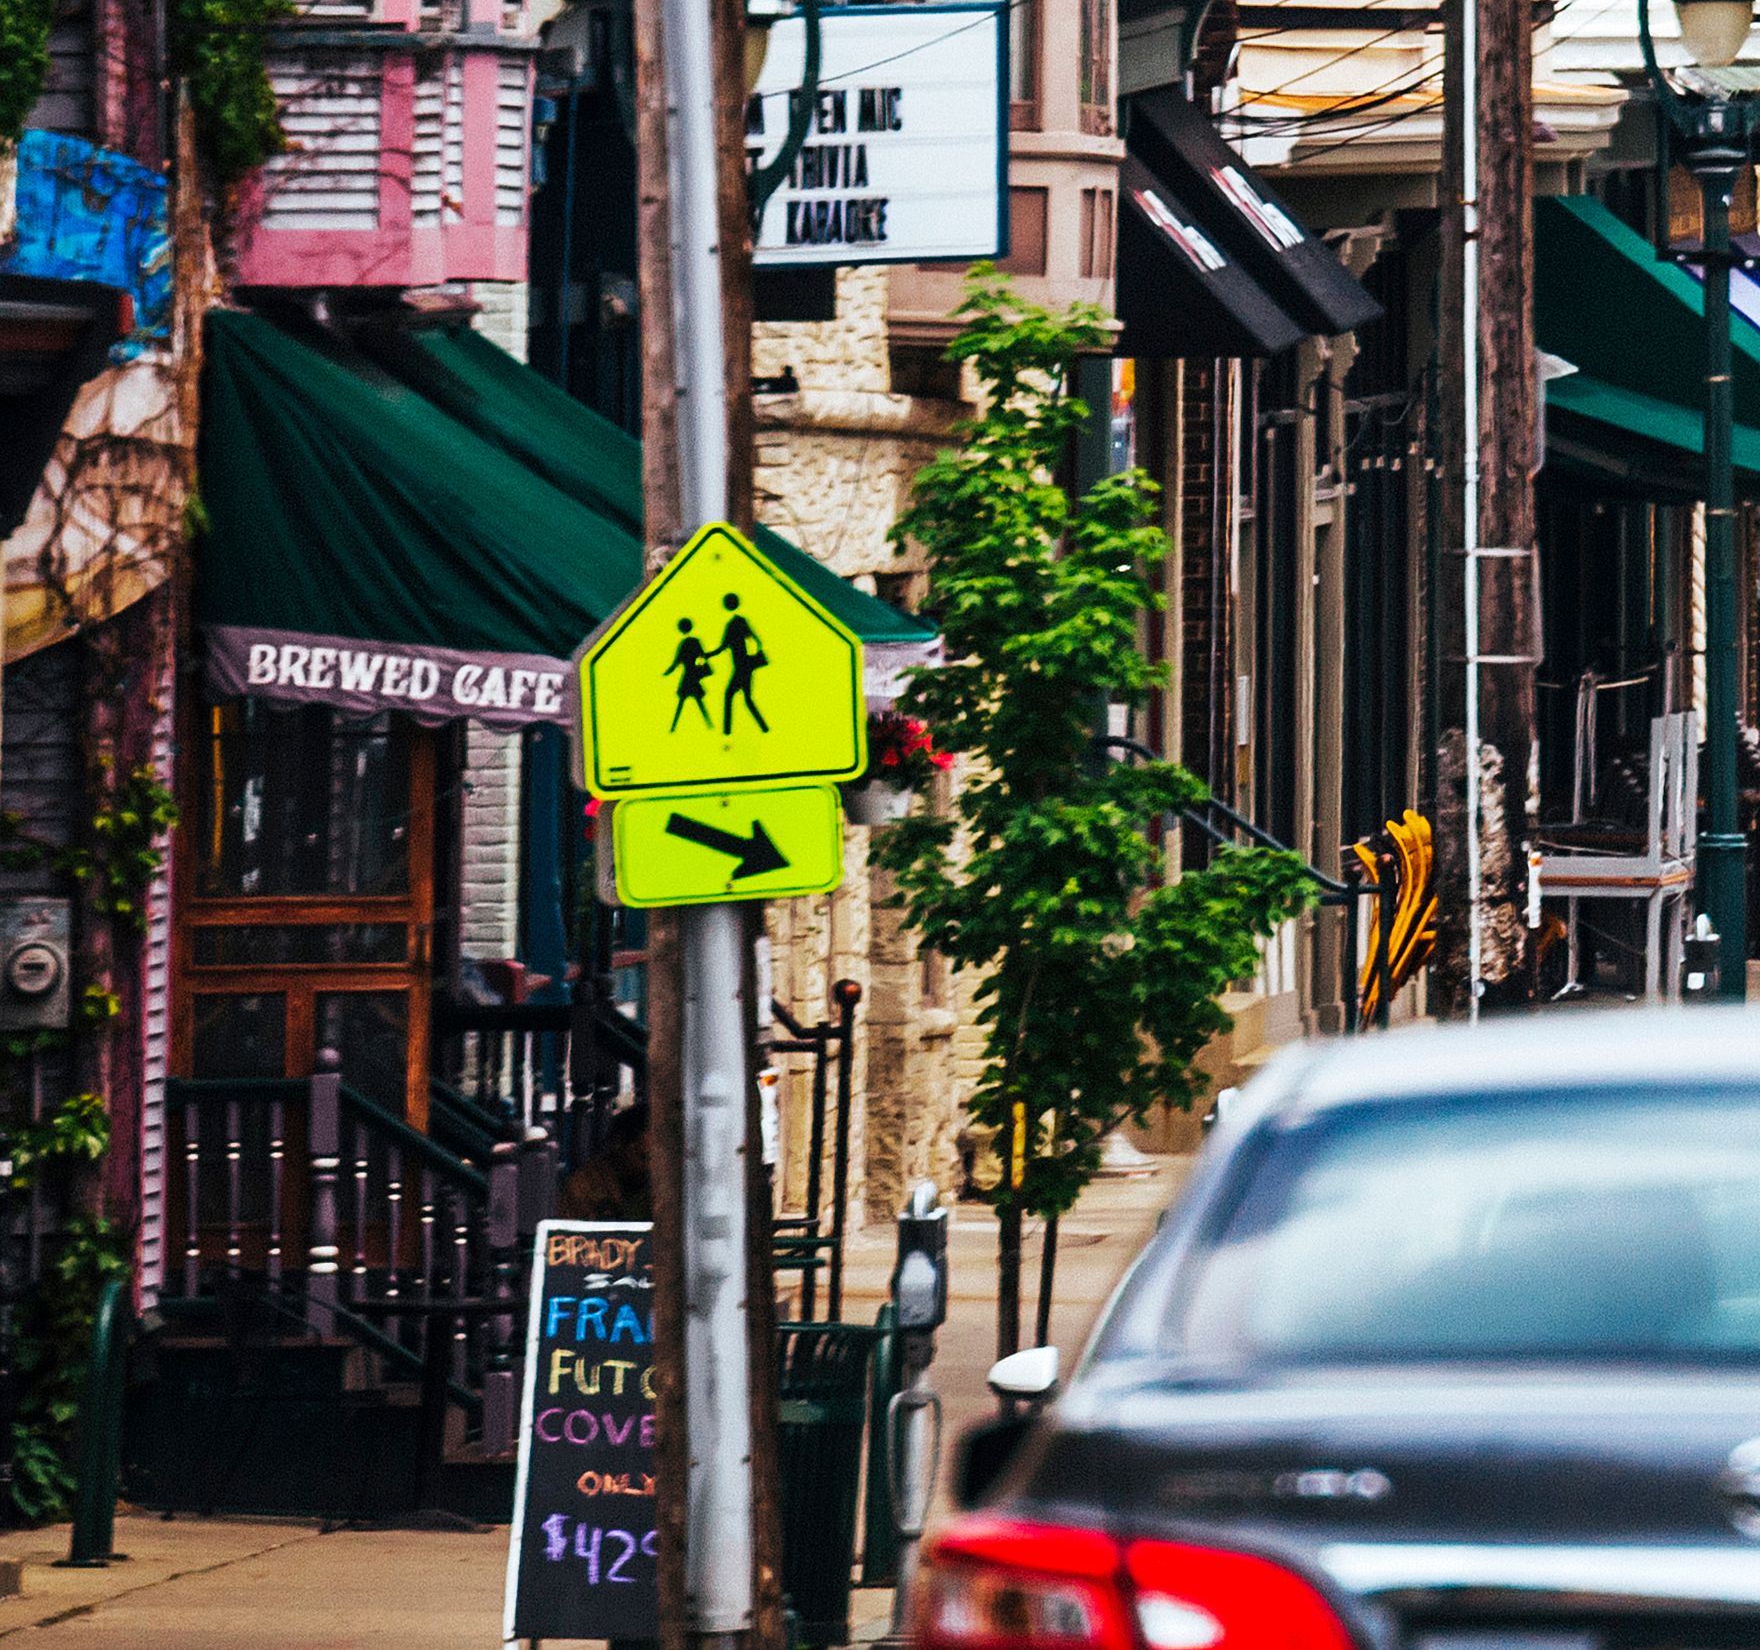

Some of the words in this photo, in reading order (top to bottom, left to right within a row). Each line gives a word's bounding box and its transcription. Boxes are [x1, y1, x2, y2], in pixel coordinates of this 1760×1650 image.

[857, 86, 902, 131] MIC
[786, 198, 889, 244] KARAOKE
[246, 643, 440, 701] BREWED
[452, 663, 565, 715] CAFE
[547, 1235, 644, 1270] BRADY
